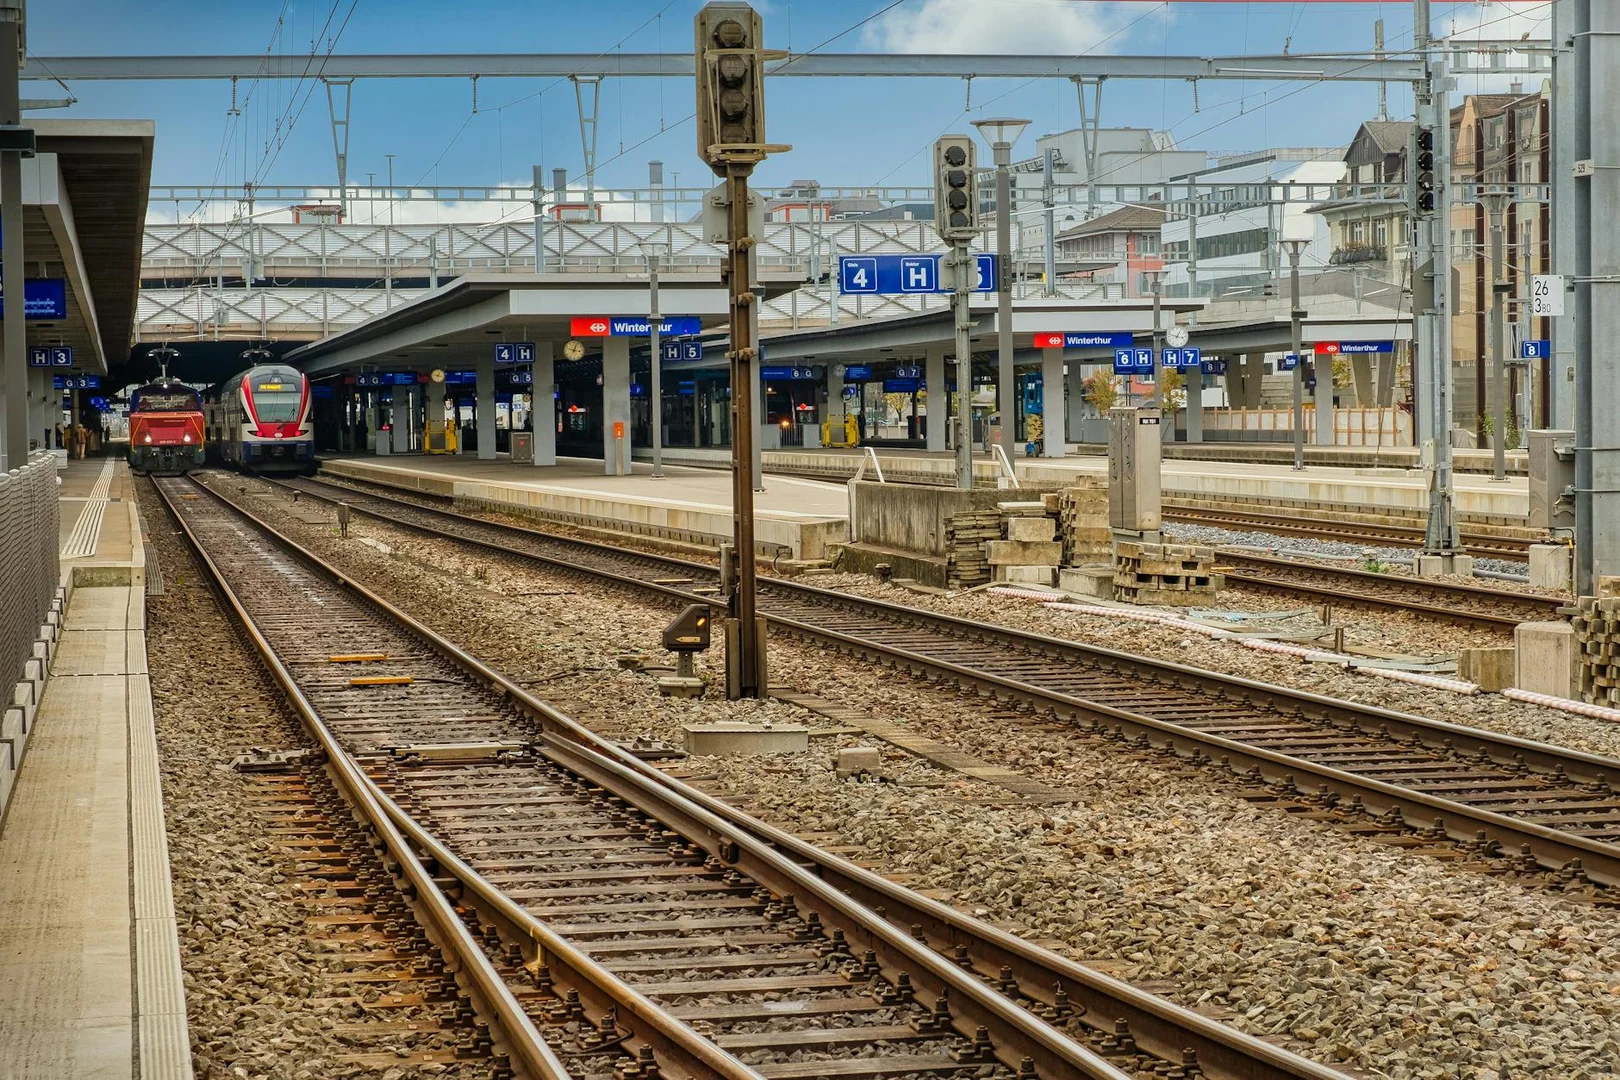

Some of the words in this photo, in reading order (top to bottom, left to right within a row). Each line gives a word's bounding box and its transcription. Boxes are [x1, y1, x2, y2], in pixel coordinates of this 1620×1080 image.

[853, 268, 868, 287] 4
[910, 268, 927, 287] H
[1534, 280, 1549, 296] 26
[1066, 336, 1112, 345] Winterthur
[501, 349, 510, 360] 4
[520, 349, 530, 360] H
[668, 347, 678, 358] H
[688, 347, 697, 358] 5
[1528, 345, 1536, 356] 8
[35, 353, 46, 364] H
[57, 353, 66, 364] 3
[1121, 354, 1129, 365] 6
[1139, 353, 1148, 364] H
[1167, 353, 1176, 364] H
[1187, 353, 1195, 364] 7
[80, 379, 86, 387] 3
[371, 376, 379, 384] G
[512, 374, 519, 382] G
[525, 374, 531, 382] 5
